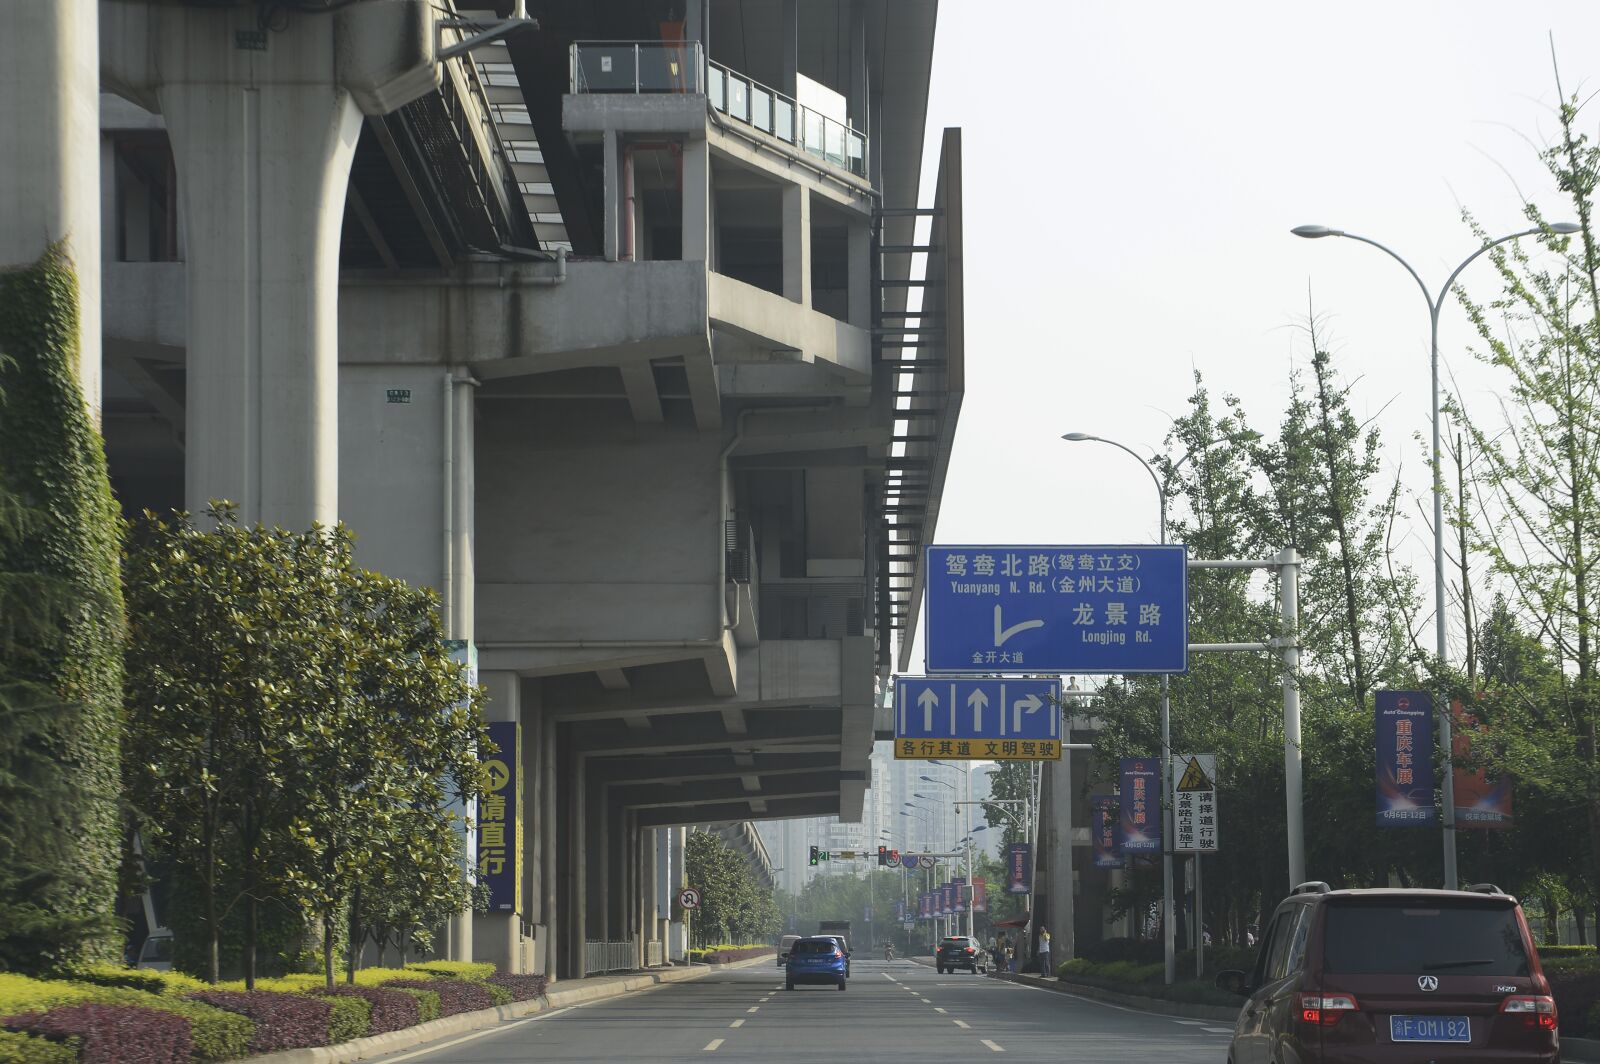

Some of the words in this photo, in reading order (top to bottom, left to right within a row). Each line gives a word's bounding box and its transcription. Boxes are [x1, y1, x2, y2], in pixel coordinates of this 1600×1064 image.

[946, 553, 1050, 577] 鸳鸯北路
[1051, 553, 1141, 572] (鸳鸯立交)
[951, 581, 1000, 595] Yuanyang
[1010, 581, 1021, 593] N.
[1029, 581, 1046, 593] Rd.
[1051, 575, 1141, 593] (金州大道)
[1072, 602, 1162, 626] 龙景路
[1082, 630, 1126, 645] Longjing
[1136, 630, 1153, 643] Rd.
[972, 651, 1024, 664] 金开大道
[903, 741, 971, 756] 各行其道
[985, 741, 1054, 756] 文明驾驶
[1395, 719, 1413, 784] 重庆车展
[1178, 792, 1194, 849] 龙景路占道施工
[1199, 792, 1215, 849] 请择道行驶
[479, 795, 506, 875] 请直行
